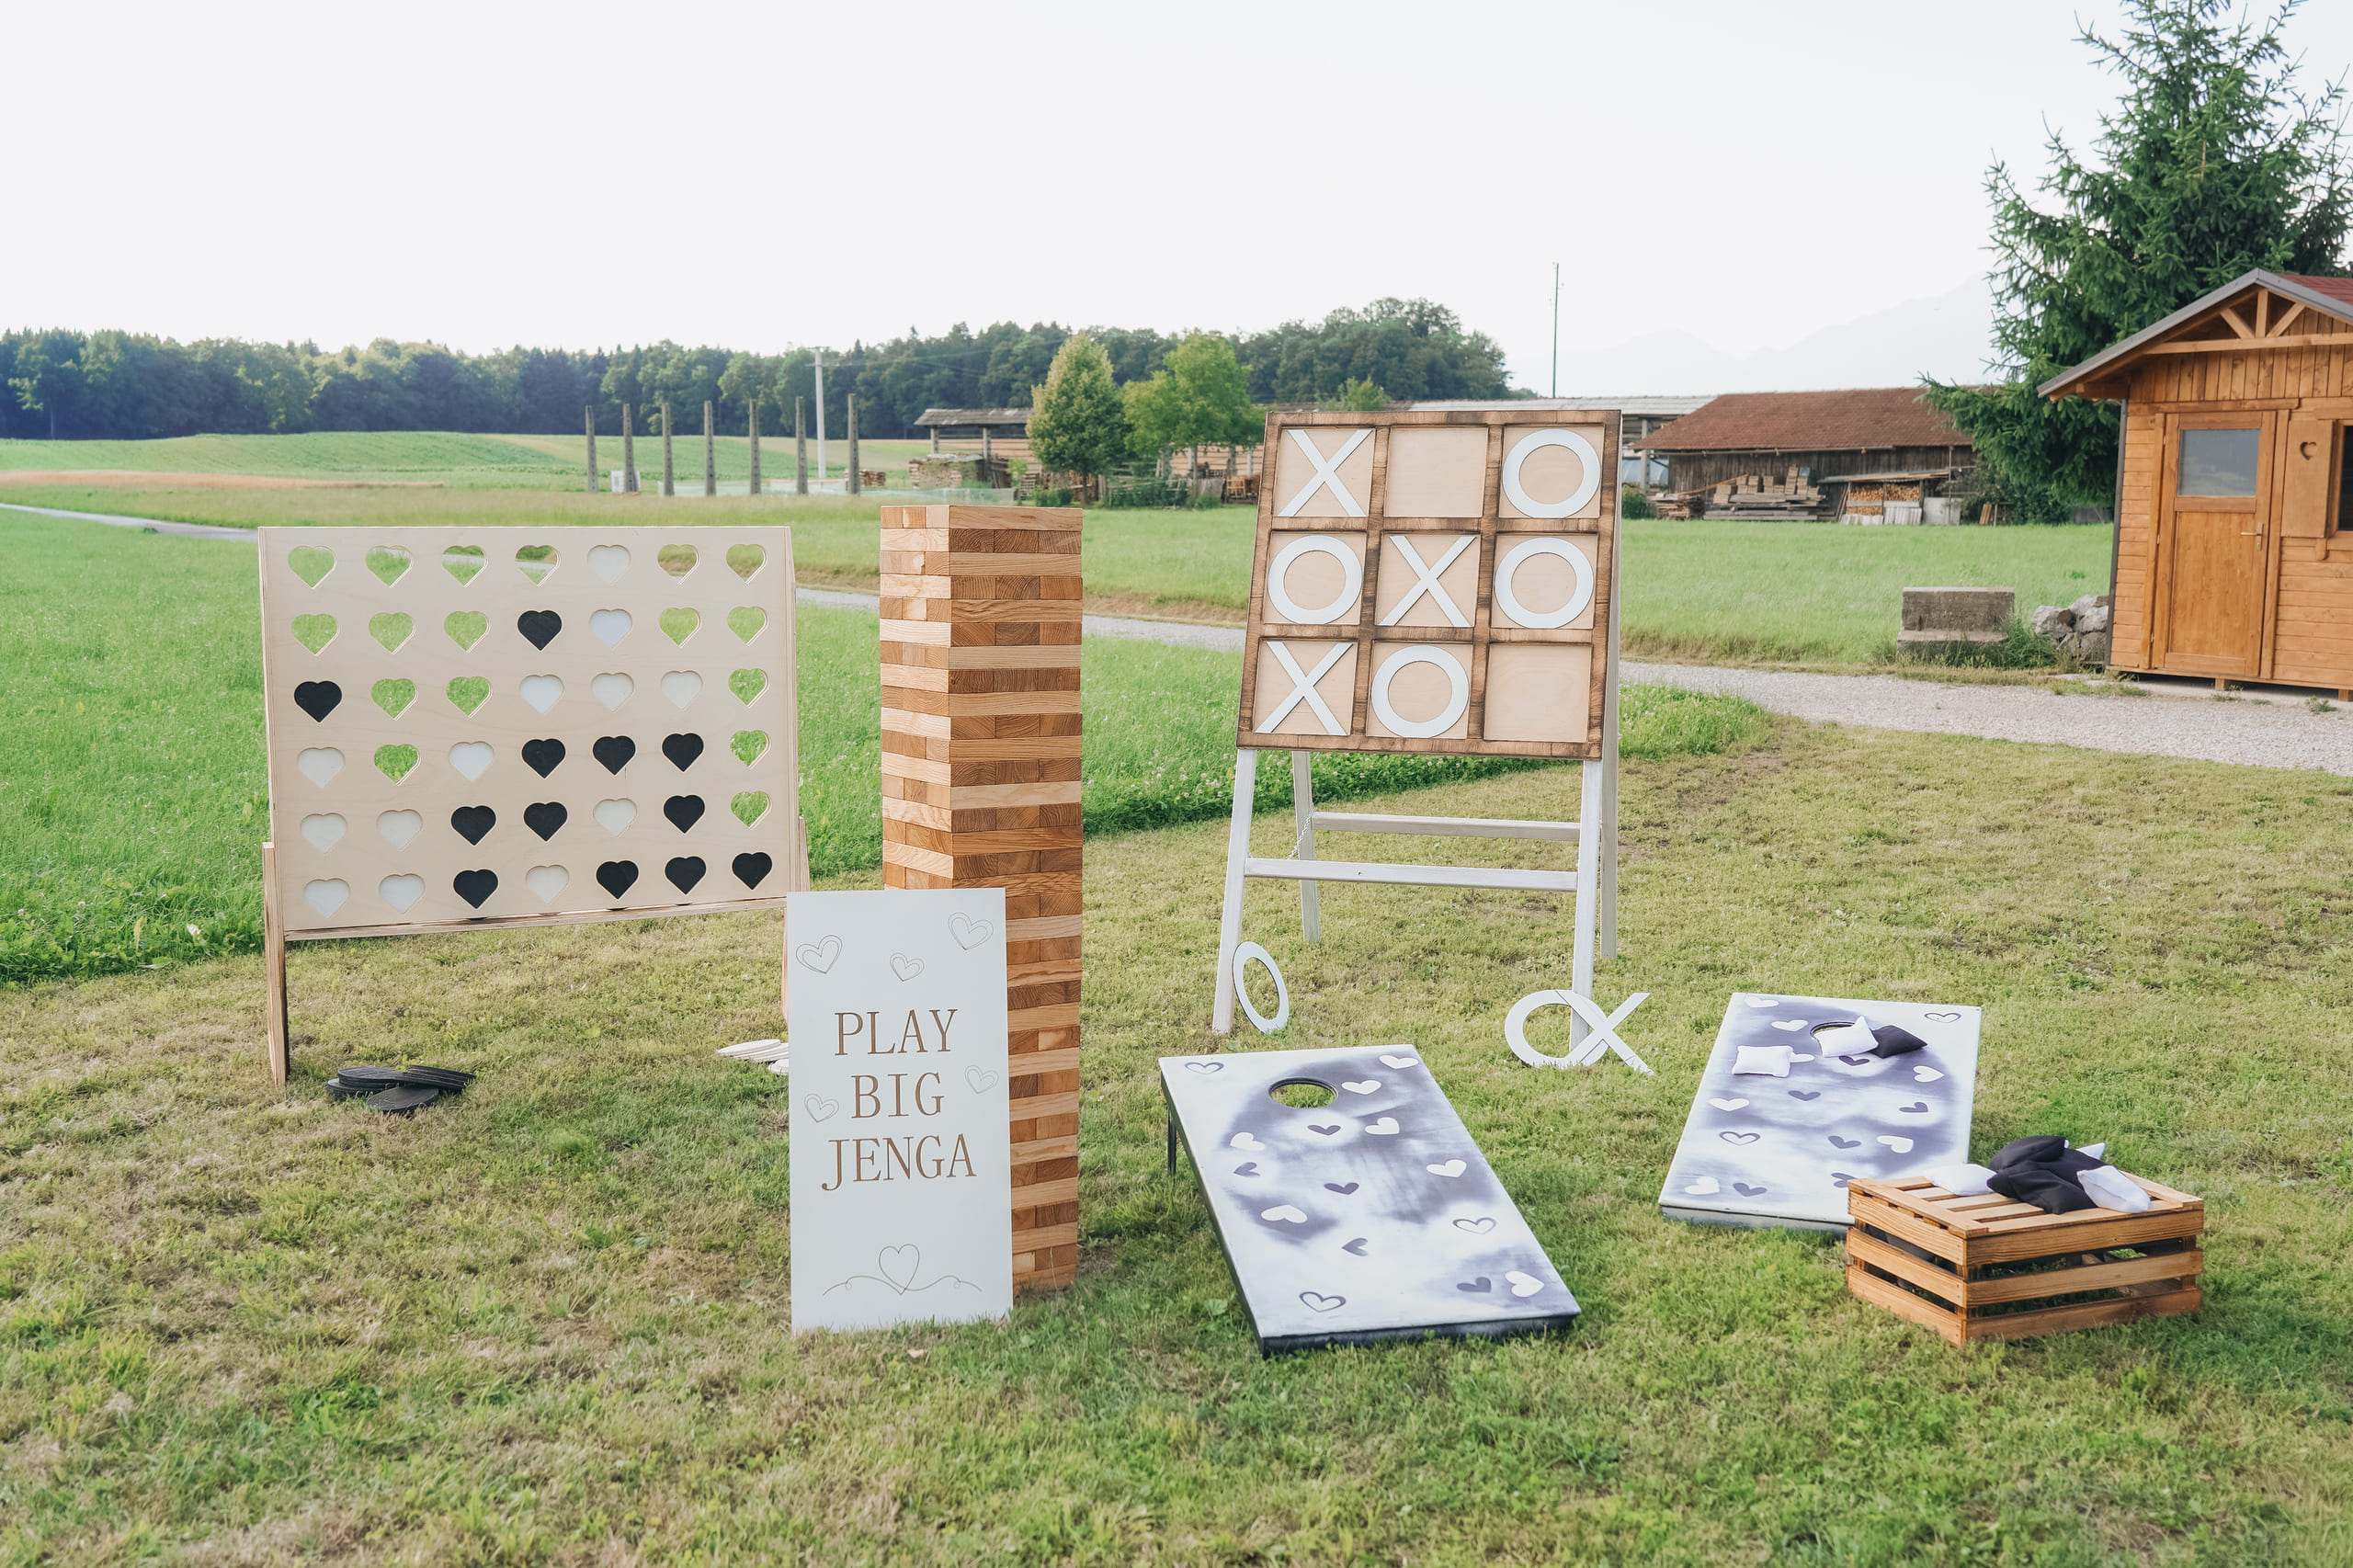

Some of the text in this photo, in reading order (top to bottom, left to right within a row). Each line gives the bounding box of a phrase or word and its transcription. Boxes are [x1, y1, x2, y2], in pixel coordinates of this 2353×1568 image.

[834, 1008, 958, 1056] PLAY
[851, 1072, 945, 1119] BIG
[821, 1133, 977, 1192] JENGA
